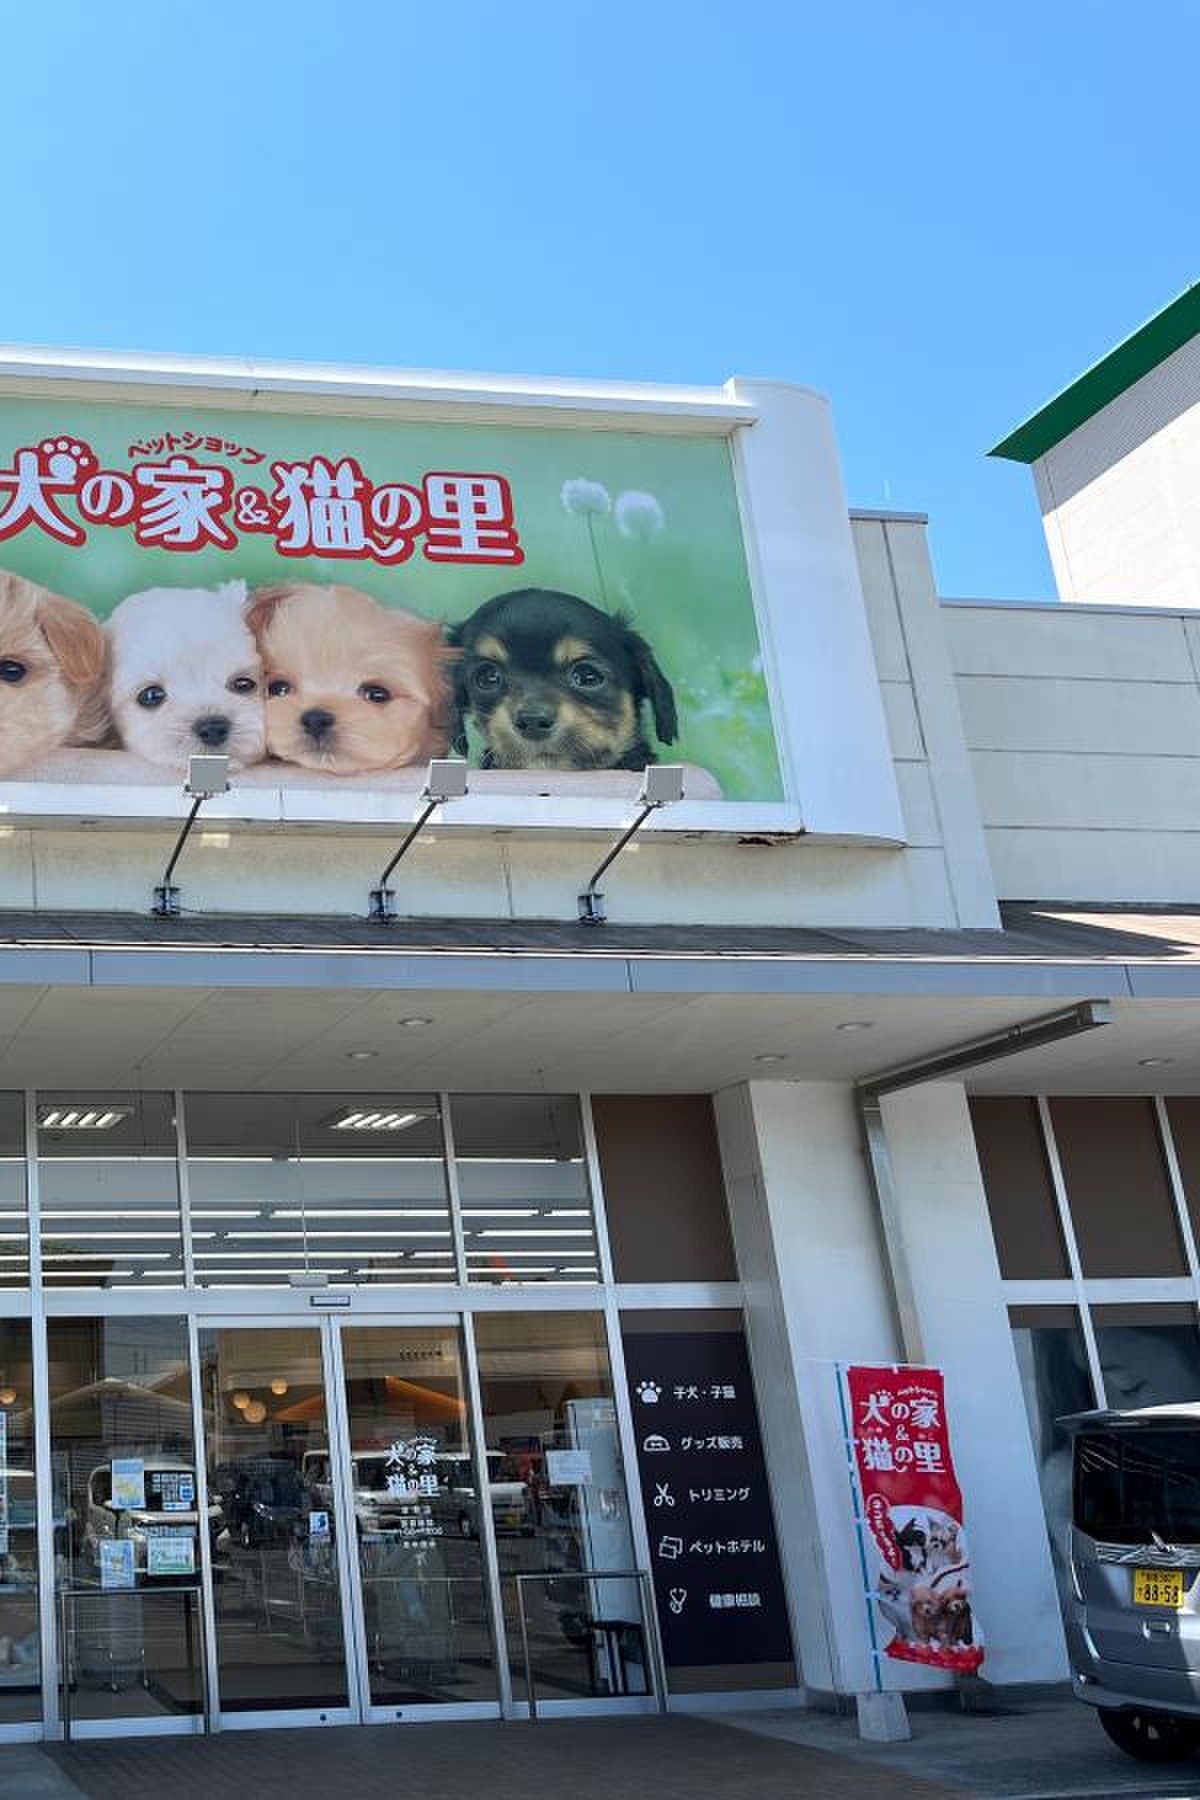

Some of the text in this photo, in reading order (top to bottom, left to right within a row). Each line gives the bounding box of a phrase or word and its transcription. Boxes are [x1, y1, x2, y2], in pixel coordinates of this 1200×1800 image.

[858, 1390, 942, 1429] 犬の家
[862, 1437, 947, 1474] 猫の里
[689, 1486, 751, 1502] トリミング
[689, 1538, 766, 1554] ペットホテル
